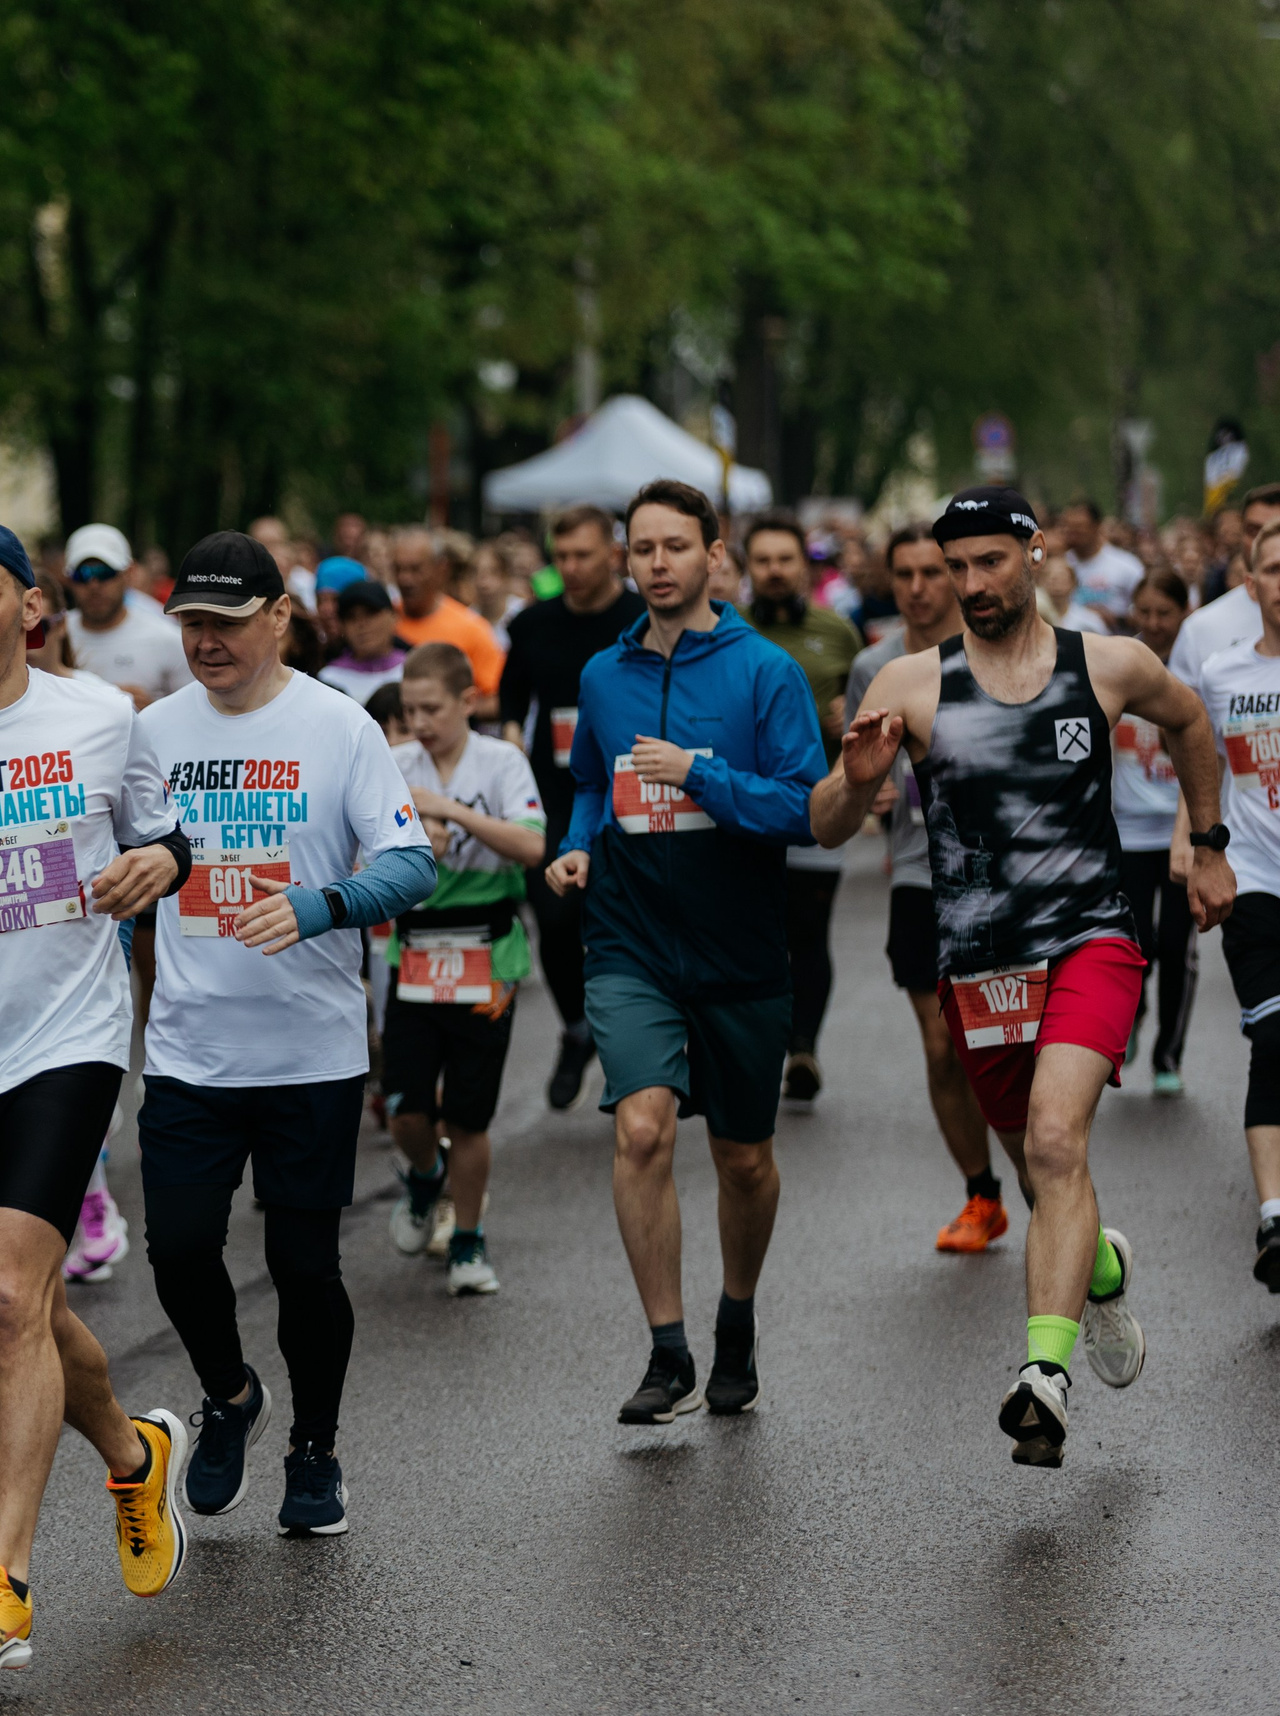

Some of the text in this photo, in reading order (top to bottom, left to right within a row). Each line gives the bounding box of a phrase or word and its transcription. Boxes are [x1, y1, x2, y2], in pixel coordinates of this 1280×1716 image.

[187, 574, 242, 585] Metso:Outotec
[169, 759, 300, 792] #ЗАБЕГ2025
[203, 792, 308, 823] ПЛАНЕТЫ
[209, 867, 253, 904] 601
[979, 974, 1028, 1014] 1027
